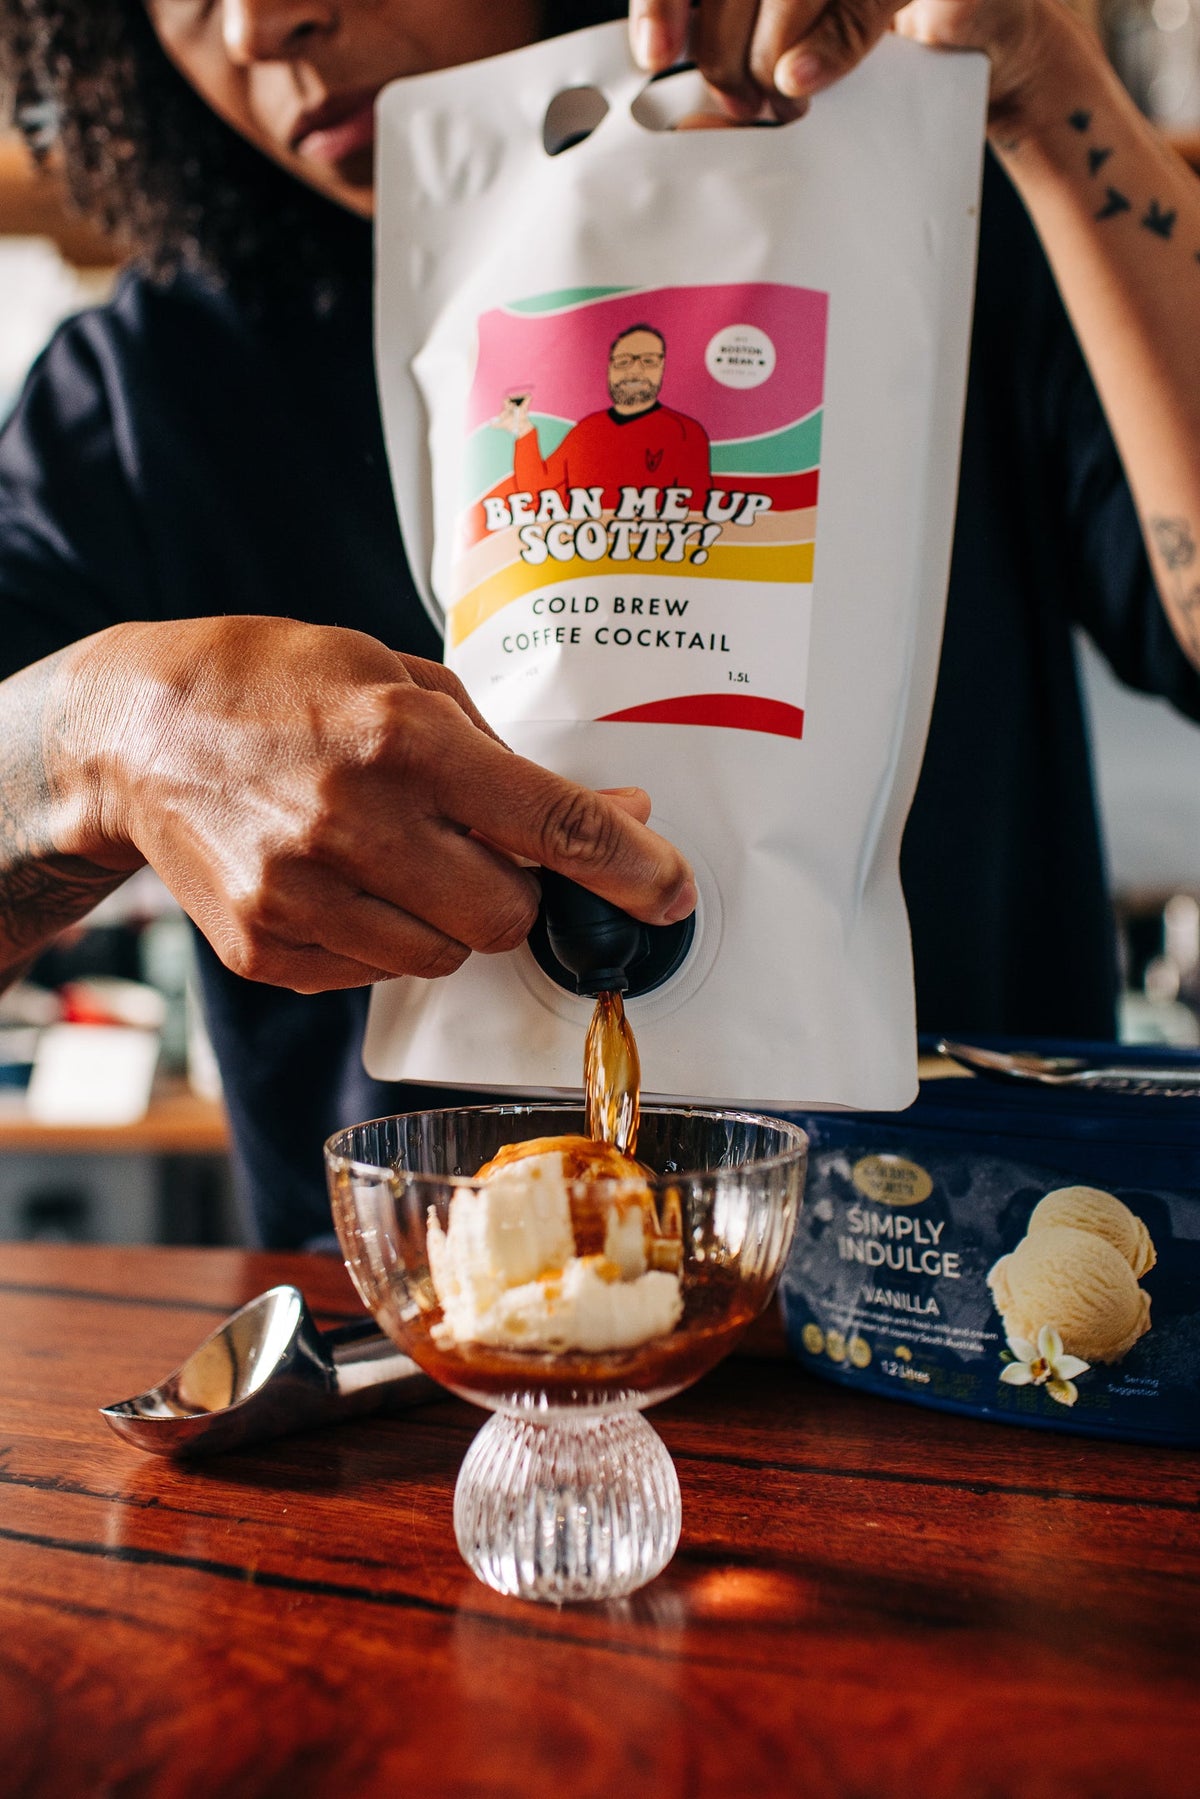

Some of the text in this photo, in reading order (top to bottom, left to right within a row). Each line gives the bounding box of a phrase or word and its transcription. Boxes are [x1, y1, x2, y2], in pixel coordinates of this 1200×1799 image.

[728, 357, 753, 366] BEAN
[481, 486, 773, 531] BEAN ME UP
[519, 519, 723, 565] SCOTTY!
[532, 596, 690, 617] COLD BREW
[502, 626, 731, 653] COFFEE COCKTAIL
[727, 671, 750, 684] 1.5L
[846, 1206, 945, 1245] SIMPLY
[837, 1235, 961, 1279] INDULGE
[860, 1287, 940, 1316] VANILLA
